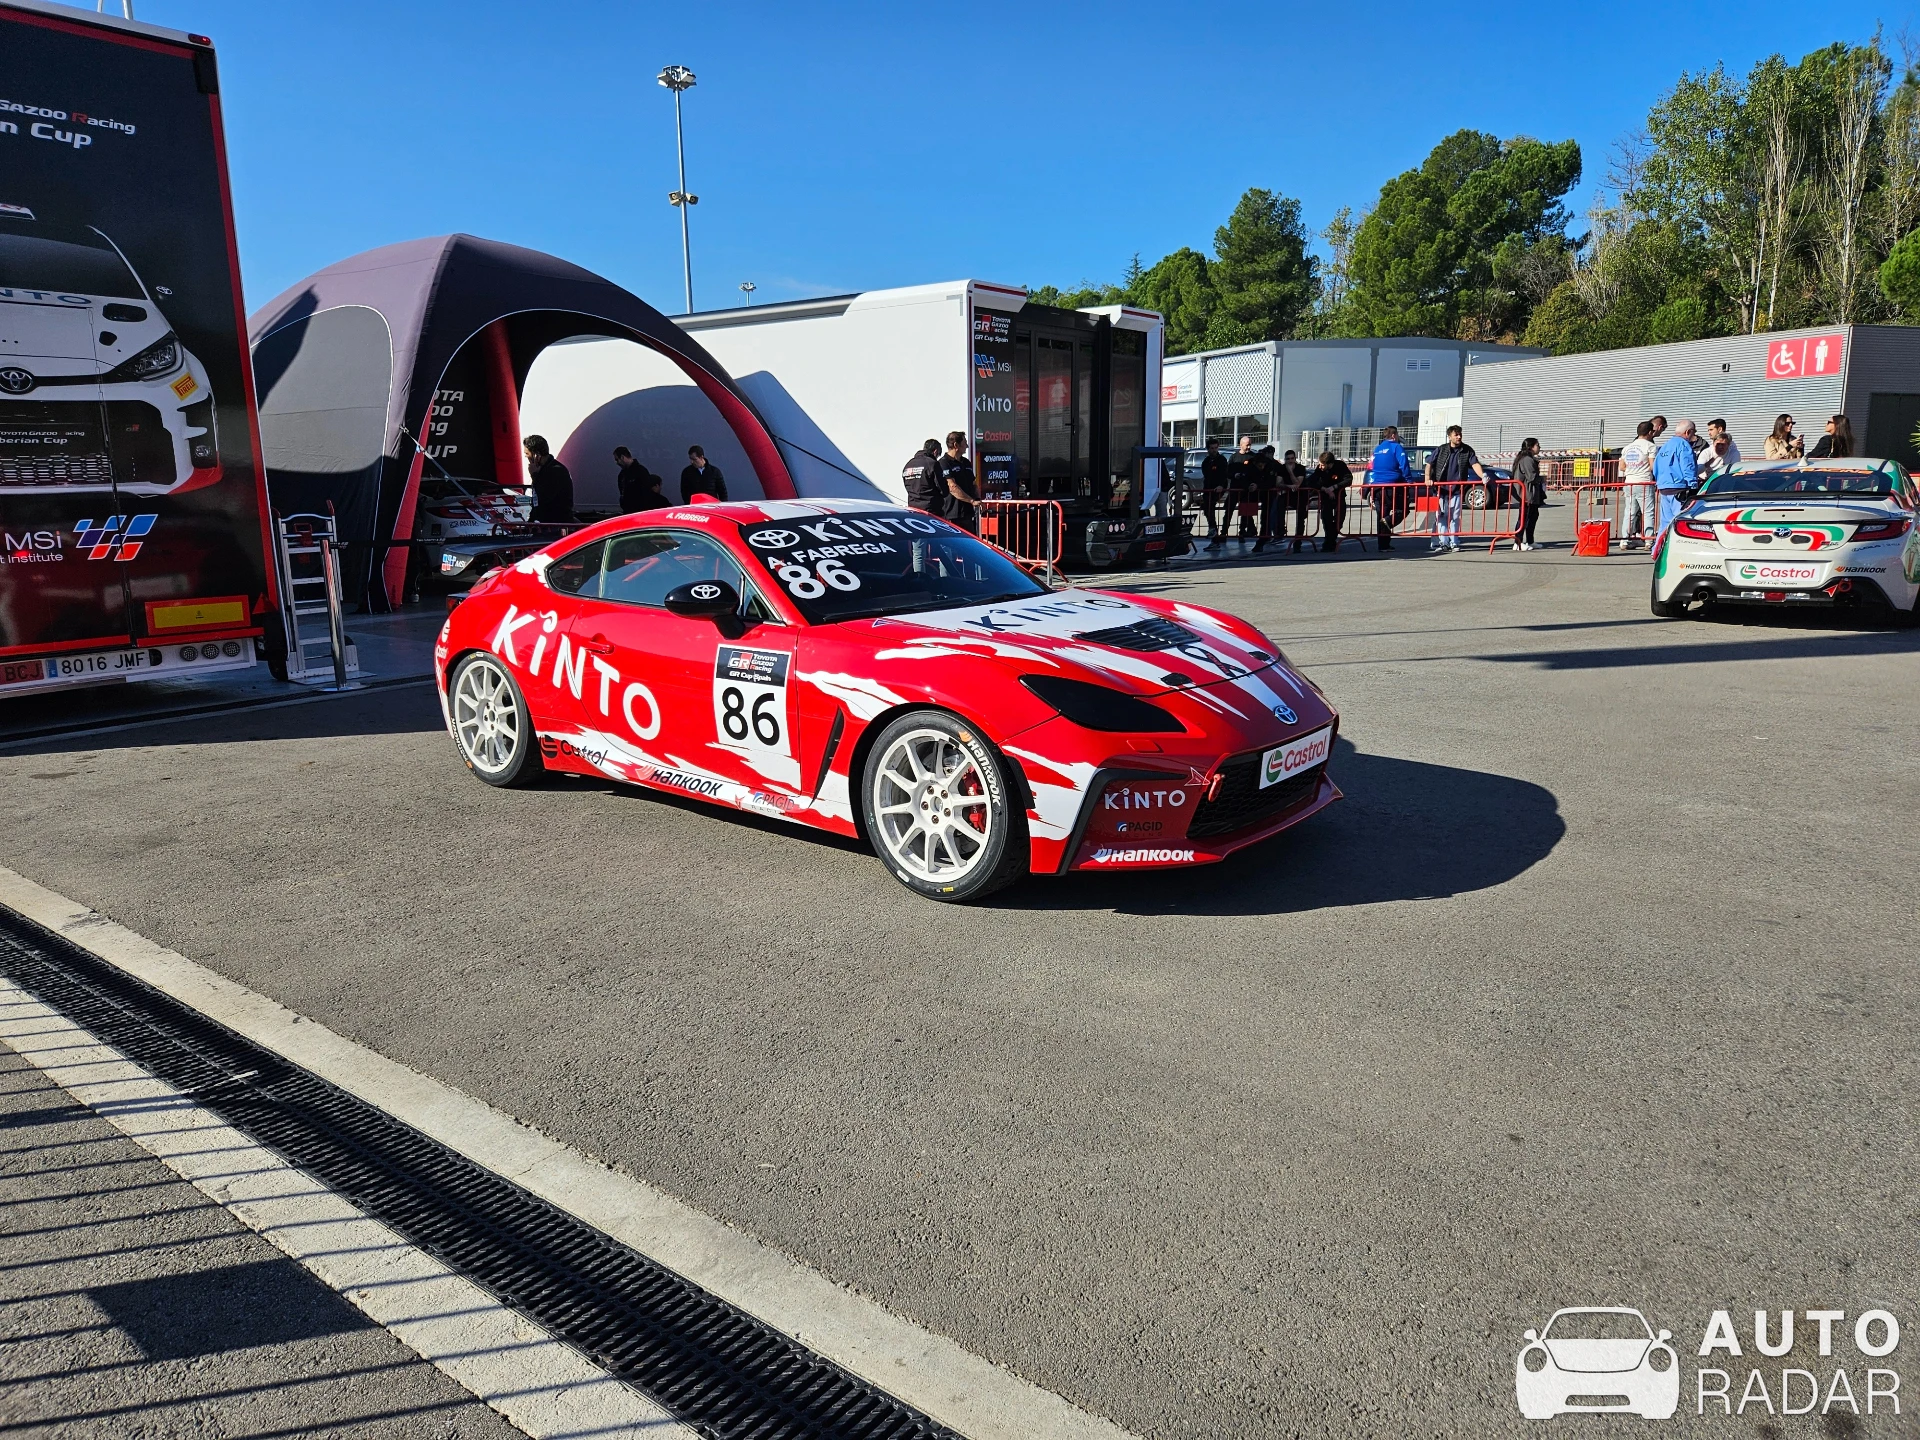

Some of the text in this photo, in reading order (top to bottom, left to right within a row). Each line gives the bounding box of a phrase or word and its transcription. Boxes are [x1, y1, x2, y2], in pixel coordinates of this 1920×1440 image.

[71, 112, 136, 135] Racing
[30, 122, 92, 149] Cup
[43, 437, 68, 445] Cup
[984, 430, 1012, 441] Castrol
[674, 513, 710, 523] FABREGA
[8, 552, 64, 564] Institute
[767, 542, 897, 570] A. FABREGA
[1760, 567, 1815, 578] Castrol
[777, 559, 861, 599] 86
[61, 656, 107, 675] 8016
[114, 651, 146, 669] JMF
[729, 657, 751, 670] GR
[753, 653, 778, 662] TOYOTA
[750, 665, 773, 673] Racing
[740, 672, 752, 680] Cup
[753, 672, 772, 682] Spain
[722, 686, 780, 746] 86
[1284, 735, 1328, 772] Castrol
[763, 794, 795, 810] PAGID
[1128, 821, 1163, 832] PAGID
